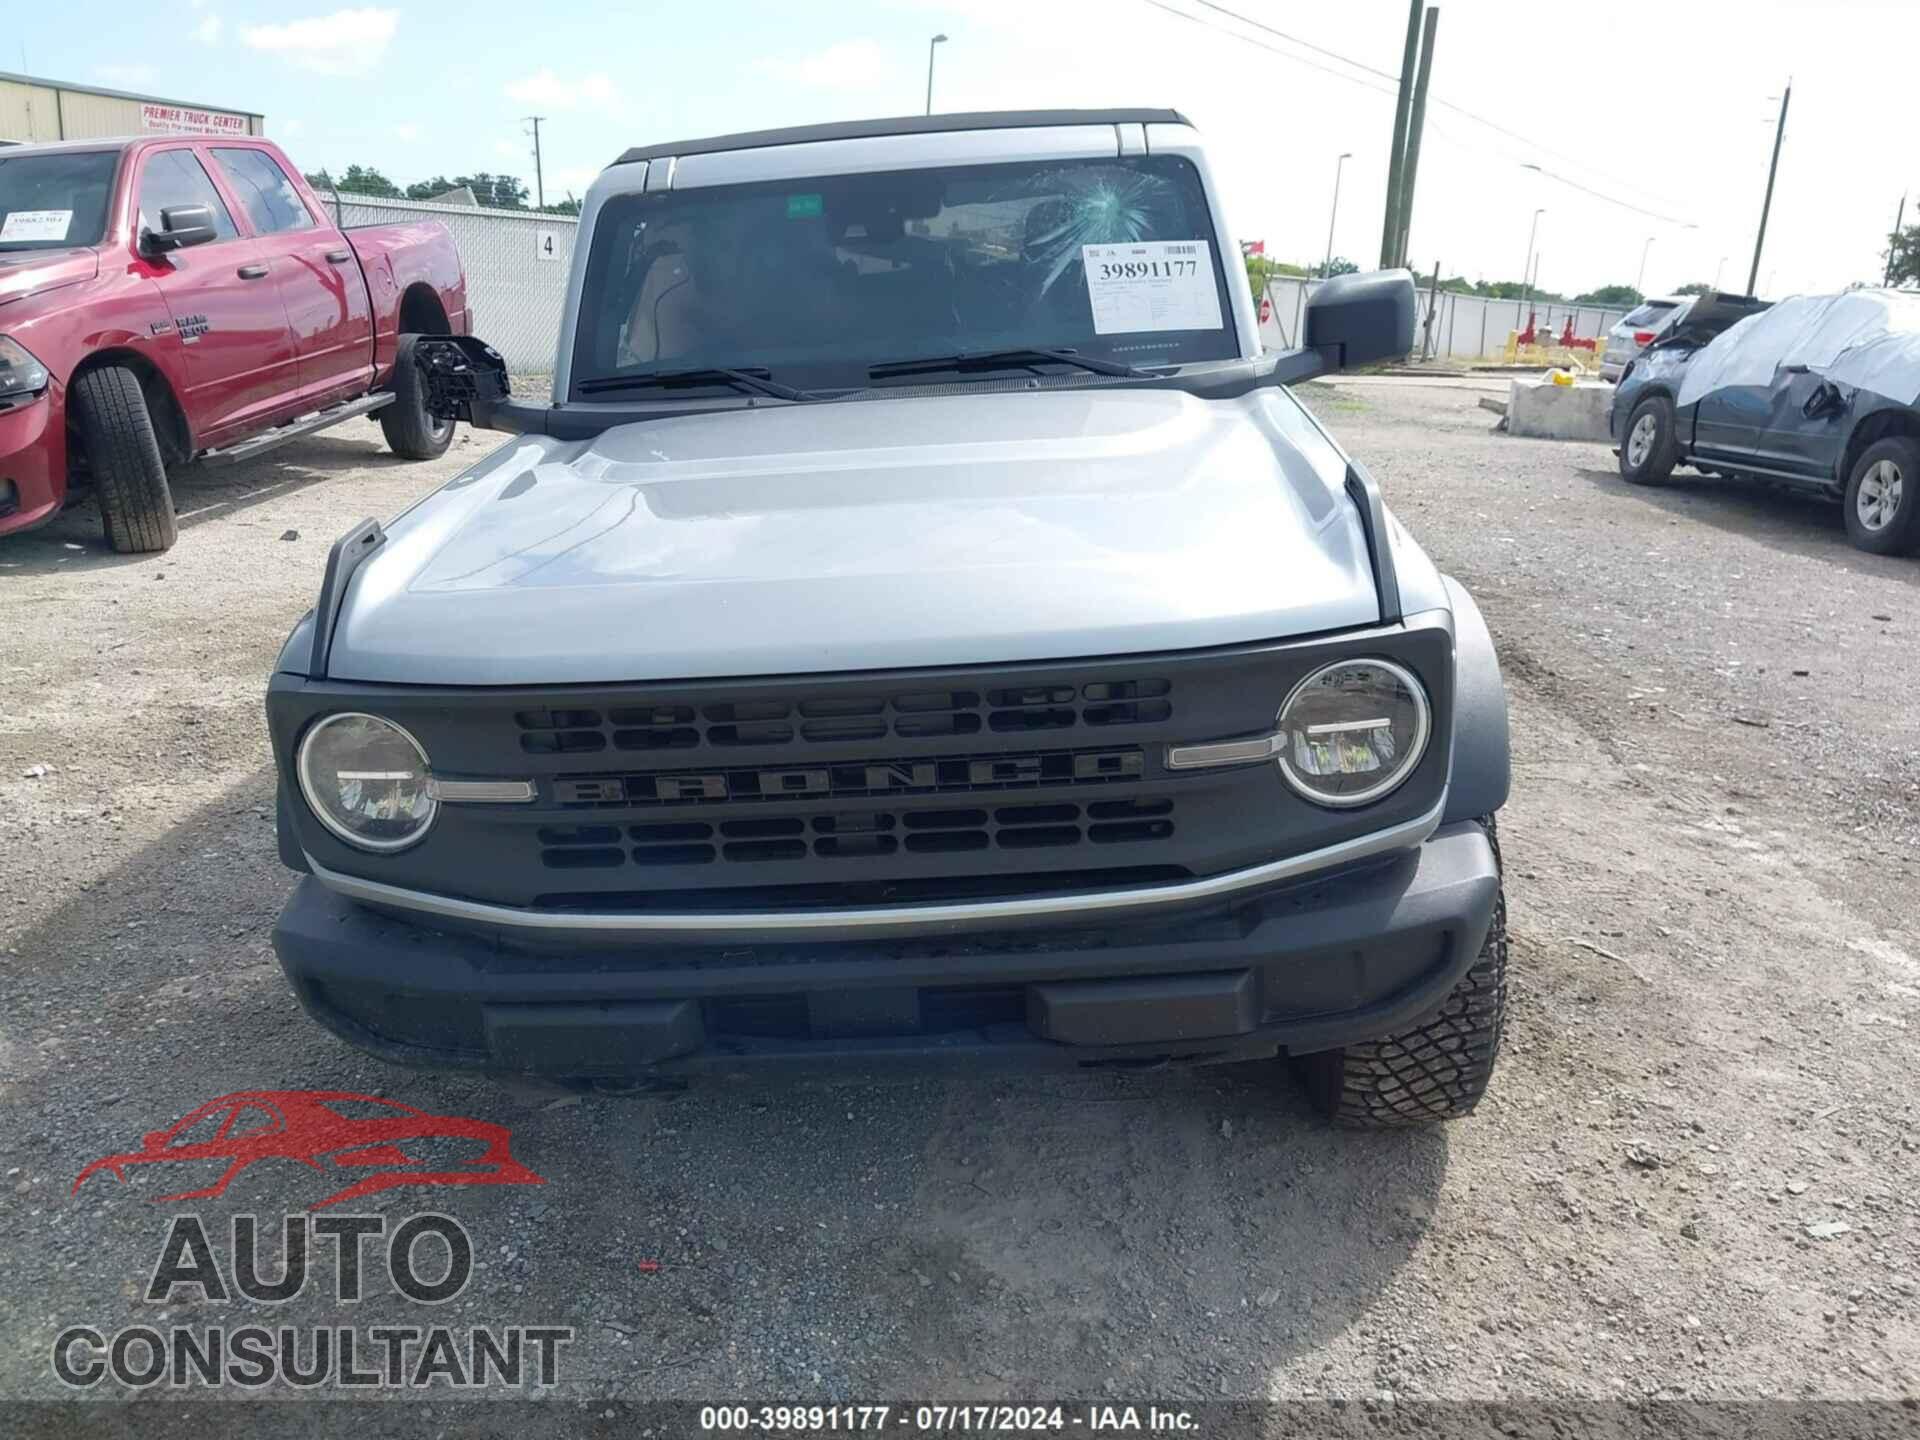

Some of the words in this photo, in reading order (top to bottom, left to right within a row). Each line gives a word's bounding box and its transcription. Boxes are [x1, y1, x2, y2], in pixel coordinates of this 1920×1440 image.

[143, 105, 181, 120] PREMIER
[184, 111, 209, 125] TRUCK
[213, 115, 244, 129] CENTER
[543, 235, 554, 256] 4
[1100, 260, 1197, 280] 39891177
[175, 313, 208, 329] RAM
[179, 324, 209, 339] 1500
[557, 751, 1144, 802] BRONCO
